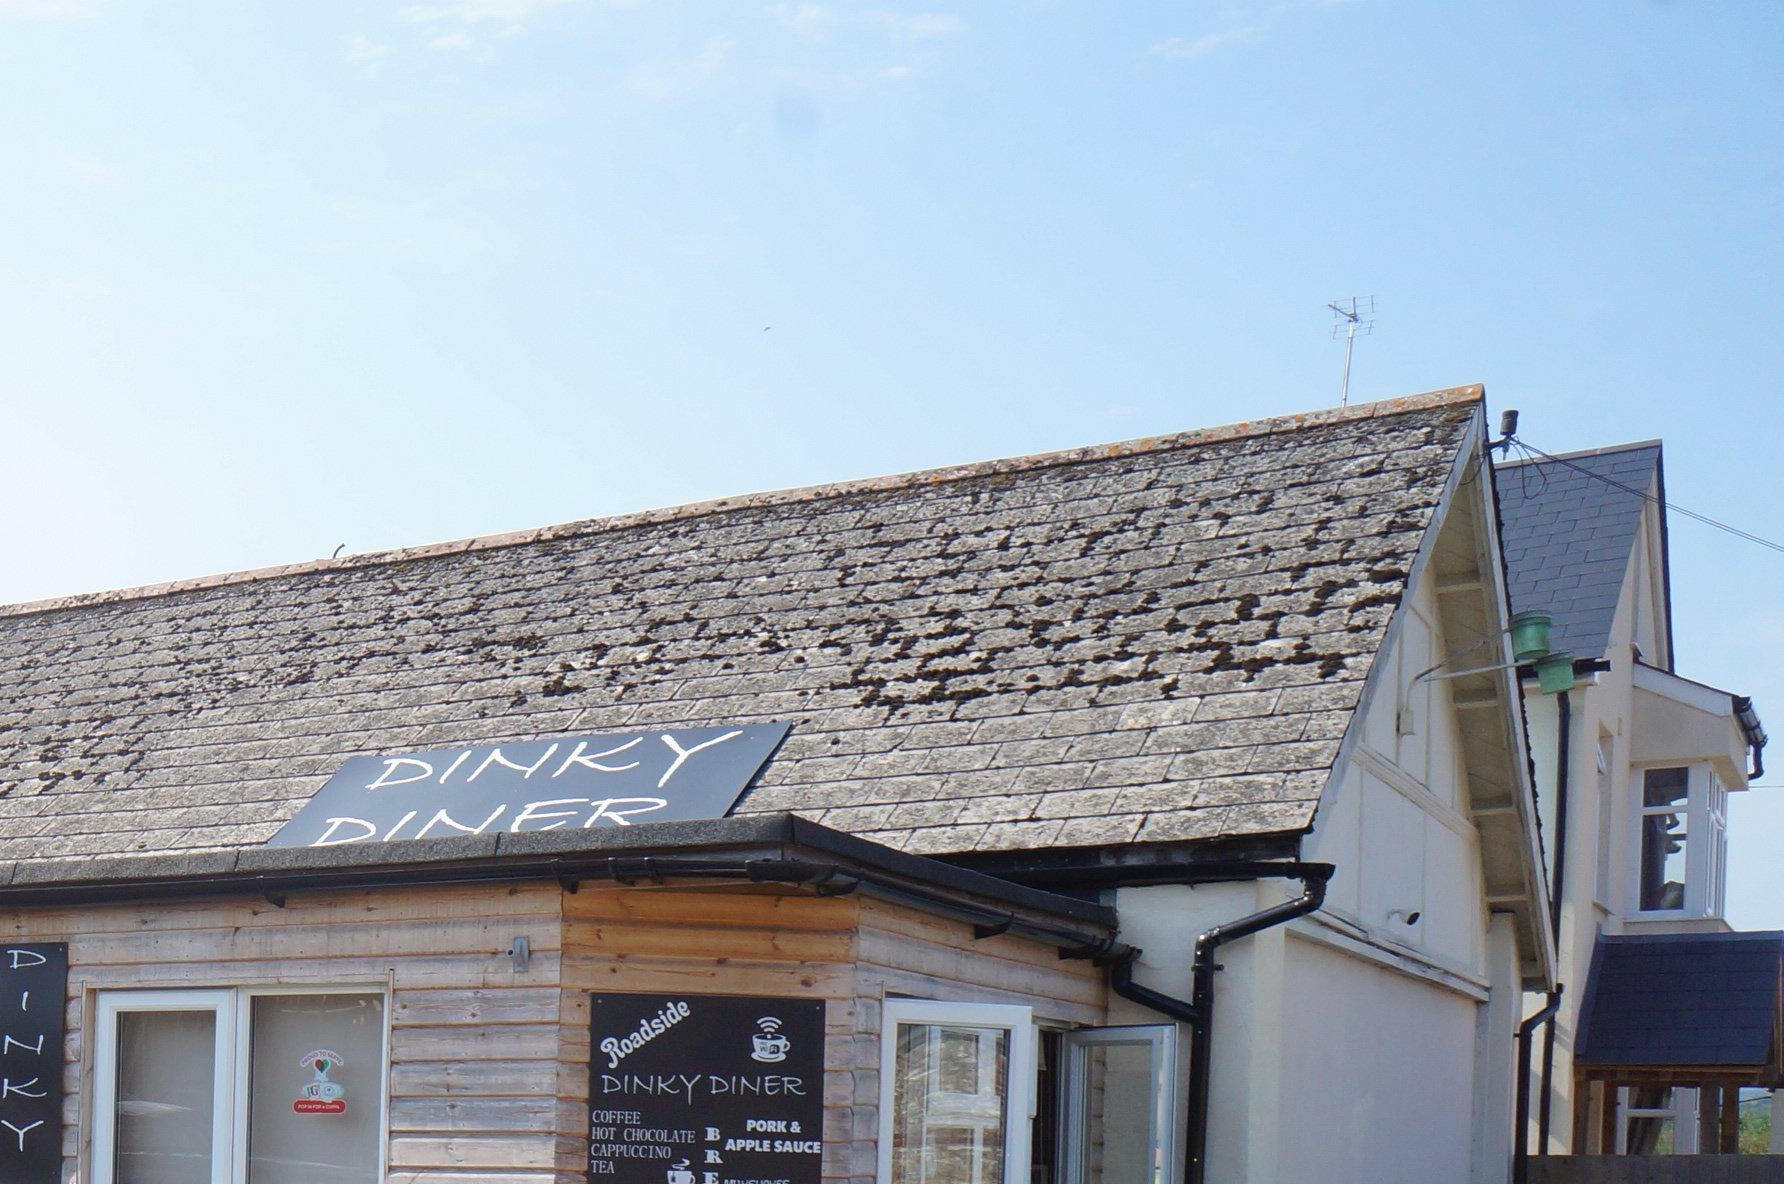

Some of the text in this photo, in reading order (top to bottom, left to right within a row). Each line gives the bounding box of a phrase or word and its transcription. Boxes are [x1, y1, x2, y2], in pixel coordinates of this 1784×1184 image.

[365, 730, 743, 791] DINKY
[309, 797, 668, 848] DINER
[600, 1000, 691, 1069] Roadside
[0, 949, 48, 1153] DINKY
[601, 1074, 807, 1106] DINKY DINER
[592, 1110, 641, 1125] COFFEE
[746, 1119, 802, 1134] PORK &
[591, 1127, 696, 1144] HOT CHOCOLATE
[591, 1144, 672, 1160] CAPPUCCINO
[725, 1138, 822, 1154] APPLE SAUCE
[591, 1160, 615, 1175] TEA
